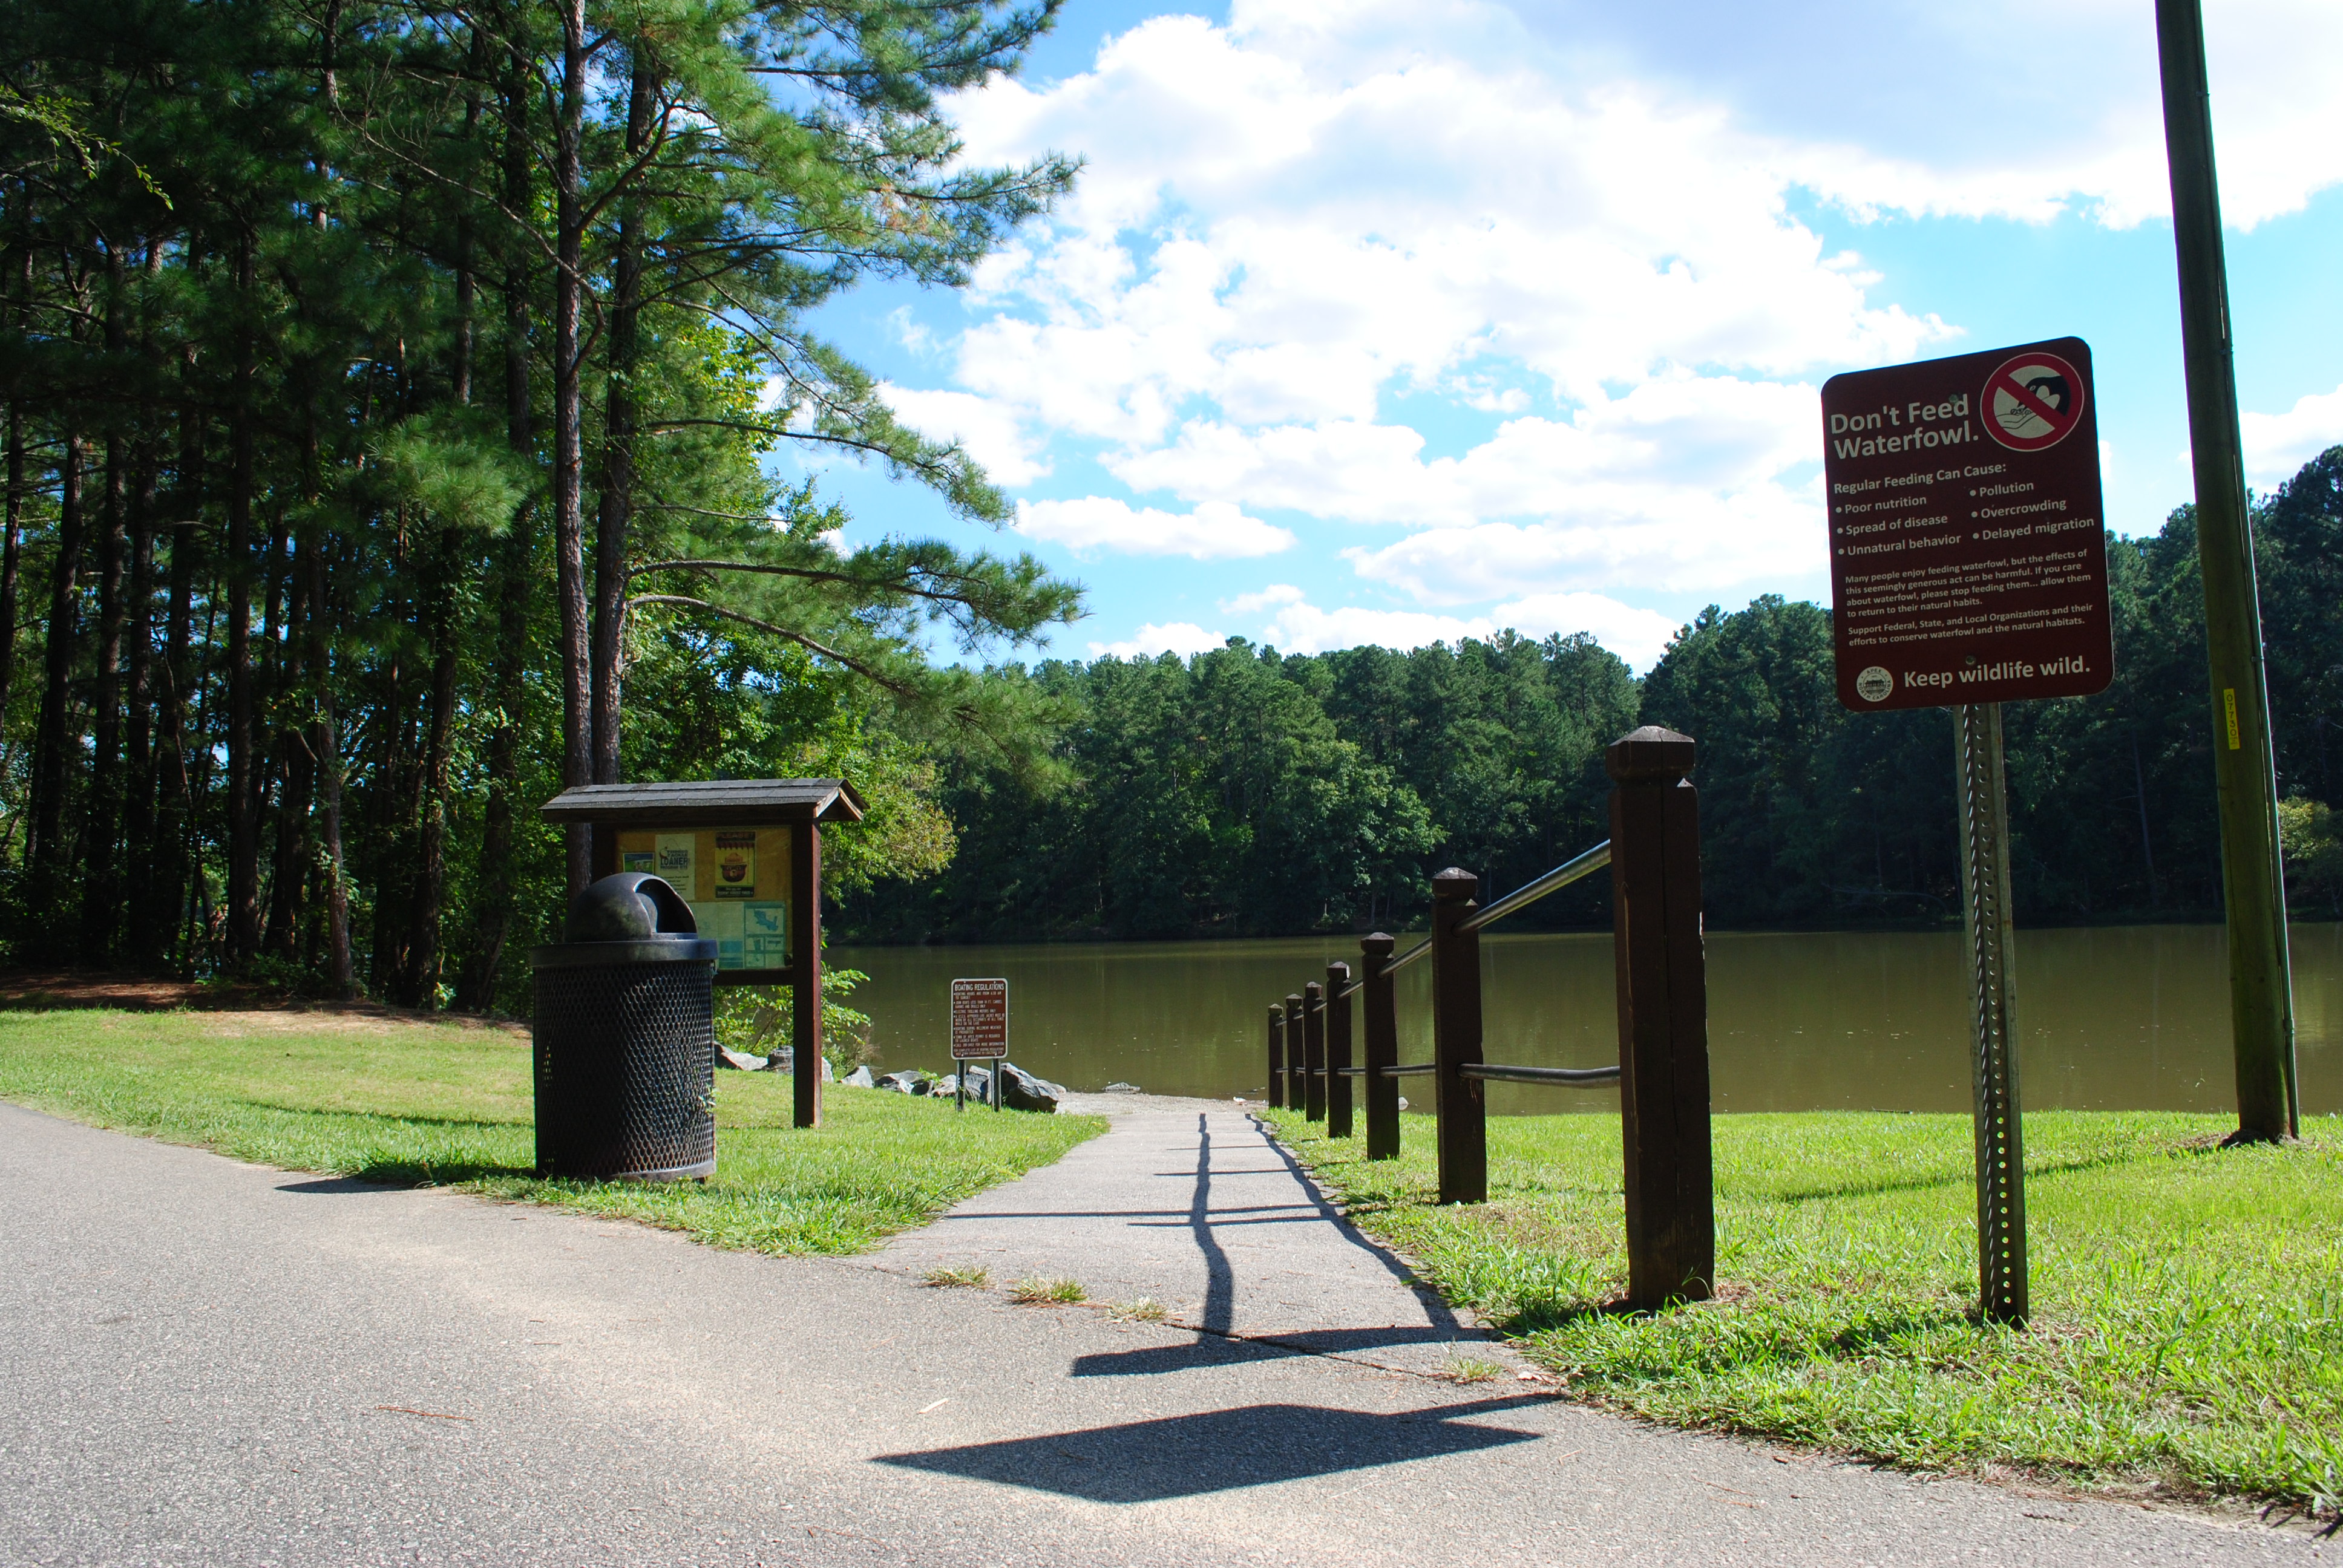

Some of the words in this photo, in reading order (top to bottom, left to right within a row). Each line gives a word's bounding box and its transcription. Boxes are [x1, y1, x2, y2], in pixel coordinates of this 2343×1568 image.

[1830, 405, 1900, 434] Don't
[1908, 393, 1969, 423] Feed
[1833, 420, 1979, 460] Waterfowl.
[1833, 479, 1881, 494] Regular
[1884, 472, 1933, 488] Feeding
[1936, 469, 1961, 481] Can
[1964, 463, 2007, 477] Cause:
[1979, 482, 2034, 497] Pollution
[1844, 503, 1872, 514] Poor
[1875, 495, 1927, 511] nutrition
[1981, 499, 2066, 518] Overcrowding
[1846, 520, 1886, 537] Spread
[1889, 518, 1901, 530] of
[1904, 515, 1948, 528] disease
[1982, 523, 2031, 540] Delayed
[2035, 518, 2094, 534] migration
[1847, 539, 1906, 556] Unnatural
[1909, 534, 1961, 549] behavior
[1845, 575, 1869, 584] Many
[1870, 570, 1900, 583] people
[1901, 568, 1926, 578] enjoy
[1927, 564, 1960, 575] feeding
[1961, 558, 2009, 571] waterfowl,
[2011, 557, 2027, 565] but
[2028, 555, 2043, 563] the
[2045, 551, 2076, 561] effects
[2077, 548, 2087, 557] of
[1845, 586, 1861, 595] this
[1863, 581, 1906, 593] seemingly
[1907, 578, 1947, 590] generous
[1949, 576, 1962, 584] act
[1981, 572, 1993, 581] be
[1994, 567, 2033, 579] harmful.
[2034, 566, 2042, 575] If
[2043, 566, 2060, 575] you
[1846, 597, 1872, 606] about
[1873, 591, 1919, 604] waterfowl,
[1921, 590, 1948, 600] please
[1950, 587, 1970, 596] stop
[1971, 583, 2005, 593] feeding
[2006, 581, 2038, 590] them...
[2040, 577, 2065, 586] allow
[2066, 574, 2091, 583] them
[1847, 625, 1882, 636] Support
[1884, 621, 1918, 632] Federal,
[1919, 619, 1944, 628] State,
[1946, 616, 1963, 626] and
[1965, 613, 1987, 624] Local
[1989, 609, 2050, 622] Organizations
[2051, 605, 2069, 615] and
[2071, 603, 2092, 613] their
[1858, 608, 1885, 616] return
[1897, 603, 1918, 613] their
[1920, 599, 1951, 610] natural
[1953, 597, 1982, 607] habits.
[1849, 637, 1877, 646] efforts
[1889, 633, 1928, 642] conserve
[1929, 627, 1974, 639] waterfowl
[1976, 625, 1993, 635] and
[1994, 624, 2010, 632] the
[2011, 619, 2043, 631] natural
[2045, 617, 2085, 627] habitats.
[1904, 671, 1953, 688] Keep
[1958, 660, 2034, 683] wildlife
[2039, 655, 2090, 676] wild.
